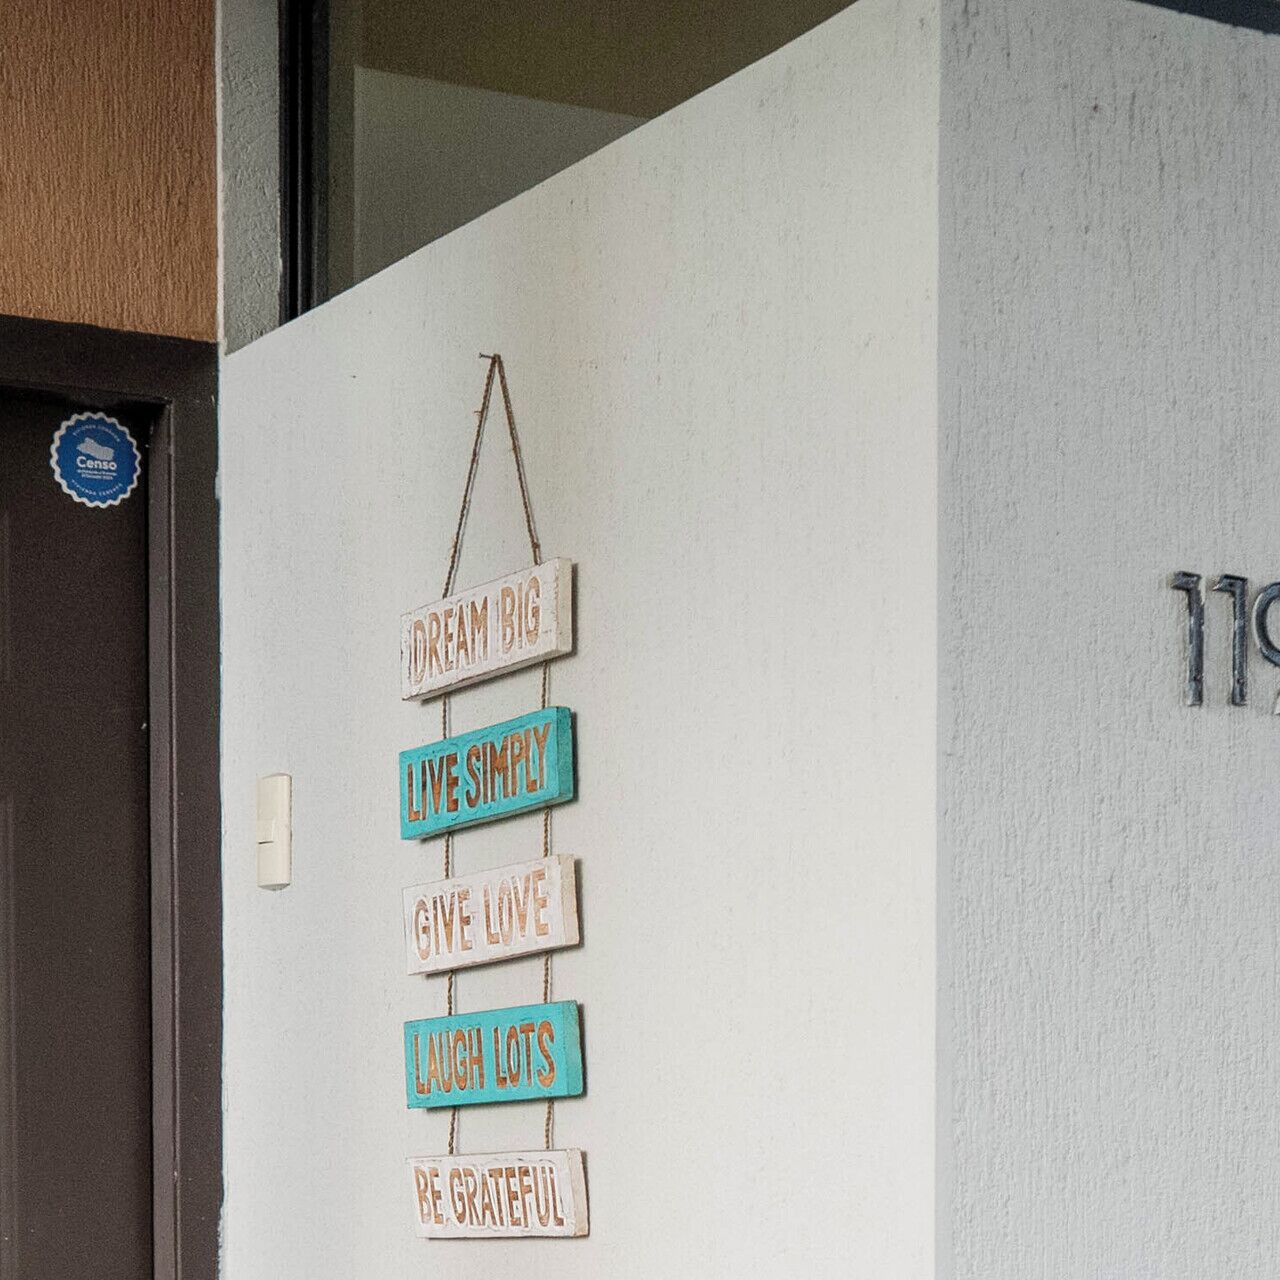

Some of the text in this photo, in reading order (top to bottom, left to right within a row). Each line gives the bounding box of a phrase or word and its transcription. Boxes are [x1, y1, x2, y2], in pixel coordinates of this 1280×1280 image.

[76, 455, 117, 470] Censo
[411, 575, 541, 685] DREAM BIG
[407, 722, 552, 822] LIVE SIMPLY
[414, 868, 550, 961] GIVE LOVE
[414, 1020, 557, 1095] LAUGH LOTS
[449, 1165, 566, 1229] GRATEFUL
